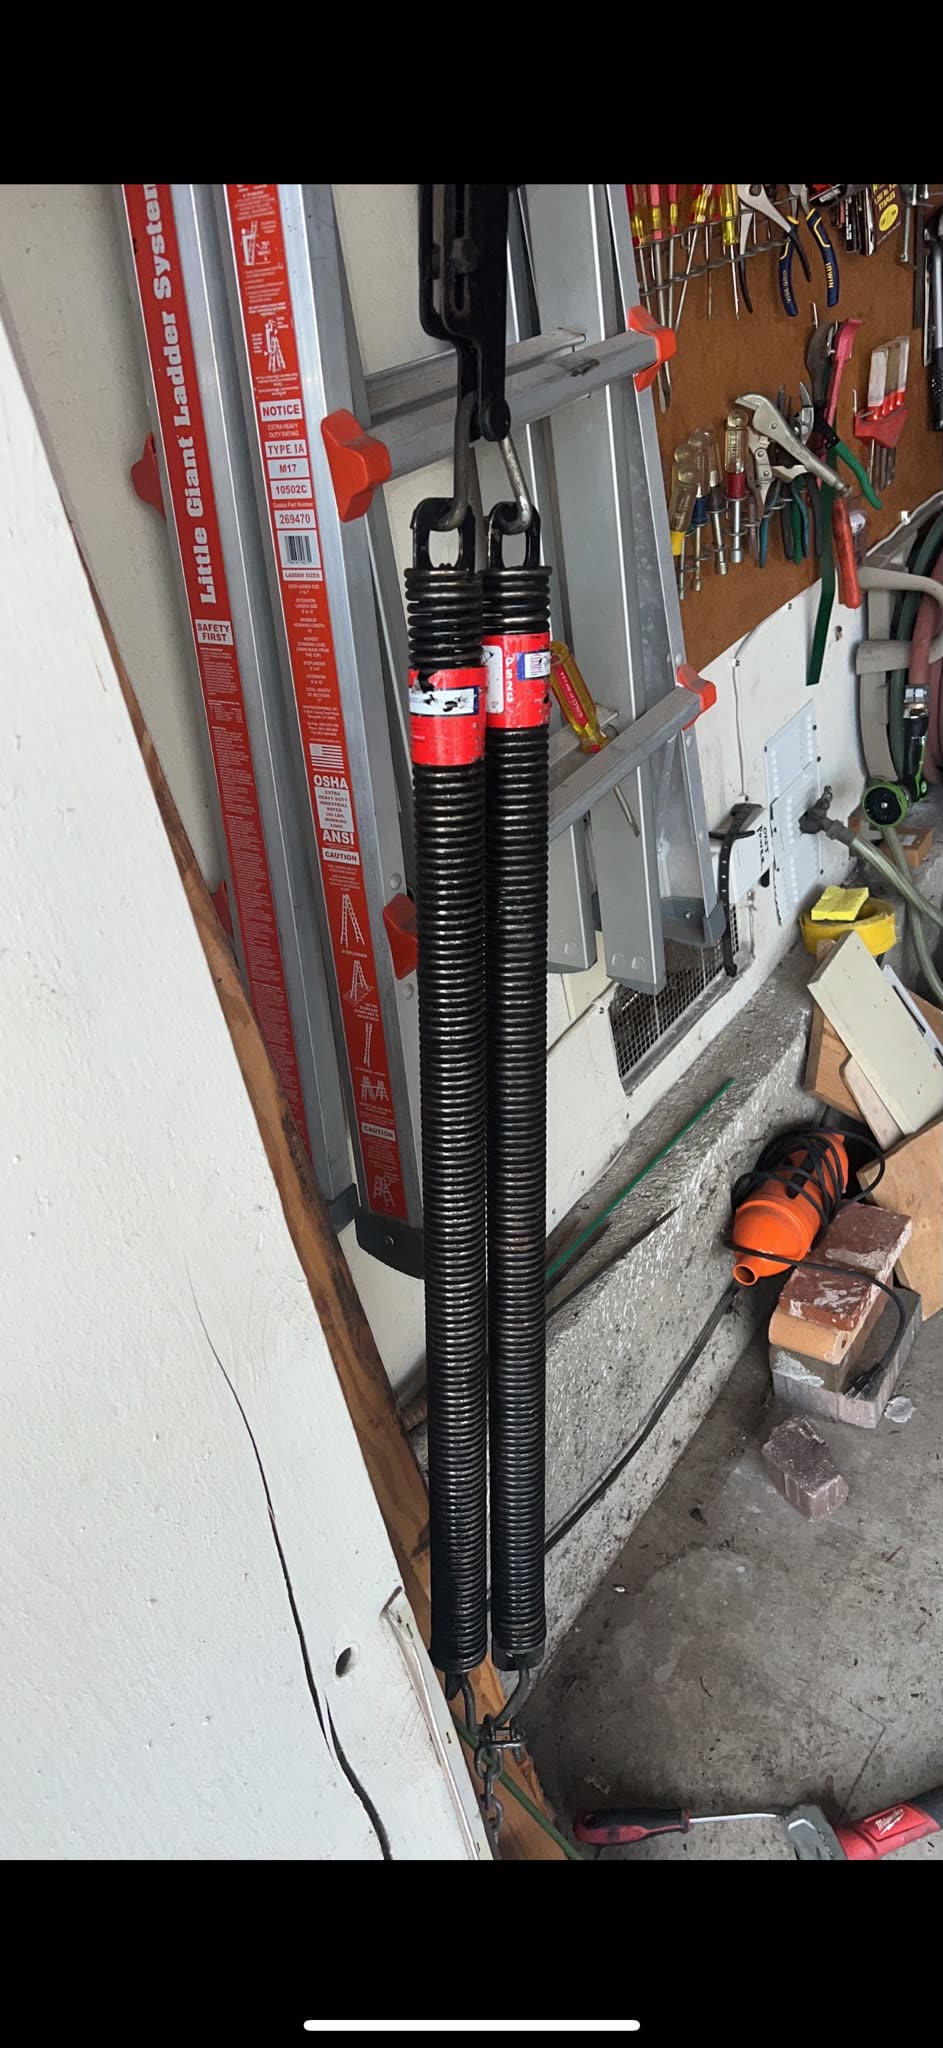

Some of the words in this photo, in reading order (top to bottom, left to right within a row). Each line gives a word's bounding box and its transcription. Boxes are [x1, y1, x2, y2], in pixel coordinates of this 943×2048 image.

[825, 262, 834, 288] IRWIN
[162, 311, 191, 426] Ladder
[262, 404, 300, 417] NOTICE
[267, 444, 291, 455] TYPE
[280, 464, 297, 473] M17
[177, 436, 204, 518] Giant
[275, 484, 307, 495] 10502C
[279, 513, 311, 525] 269470
[192, 527, 216, 603] Little
[197, 623, 229, 633] SAFETY
[202, 633, 227, 642] FIRST
[313, 774, 348, 789] OSHA
[322, 830, 354, 845] ANSI
[325, 851, 357, 863] CAUTION
[363, 1125, 394, 1139] CAUTION
